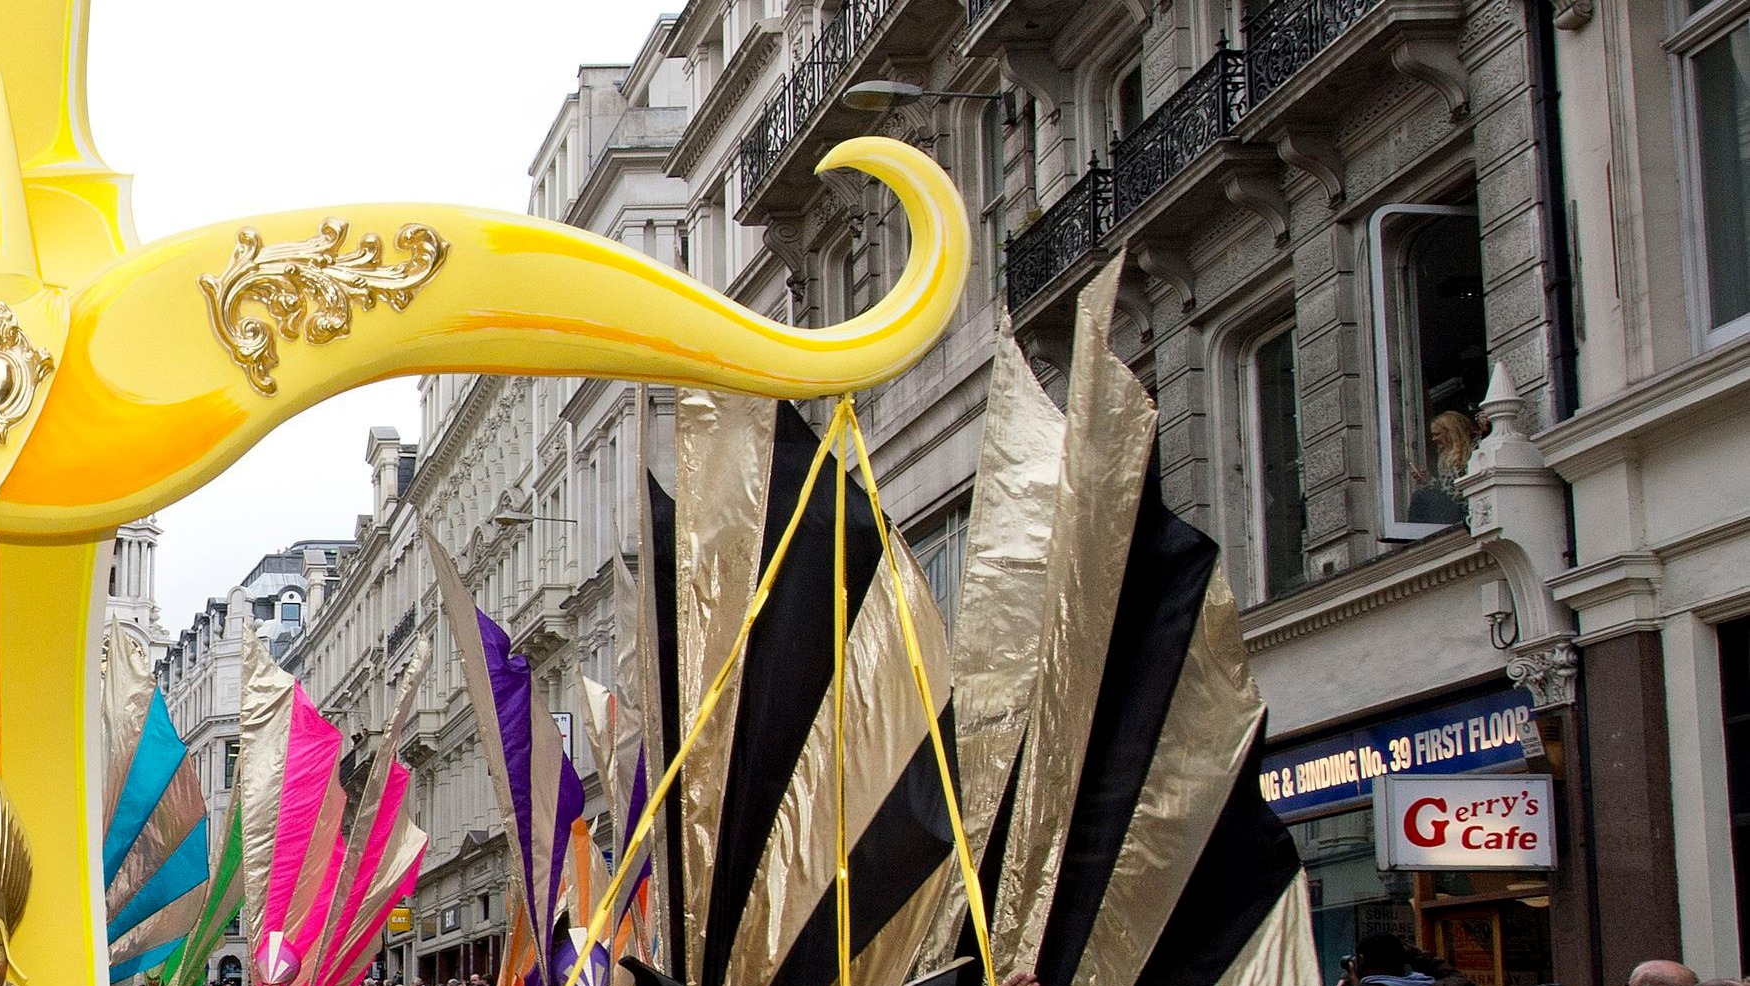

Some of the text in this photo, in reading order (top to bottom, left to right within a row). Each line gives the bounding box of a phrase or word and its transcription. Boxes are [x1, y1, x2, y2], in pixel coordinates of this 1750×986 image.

[1281, 767, 1295, 798] &
[1295, 749, 1357, 794] BINDING
[1359, 746, 1387, 779] No.
[1388, 736, 1412, 772] 39
[1415, 721, 1464, 766] FIRST
[1403, 790, 1539, 847] Gerry's
[1461, 825, 1538, 850] Cafe
